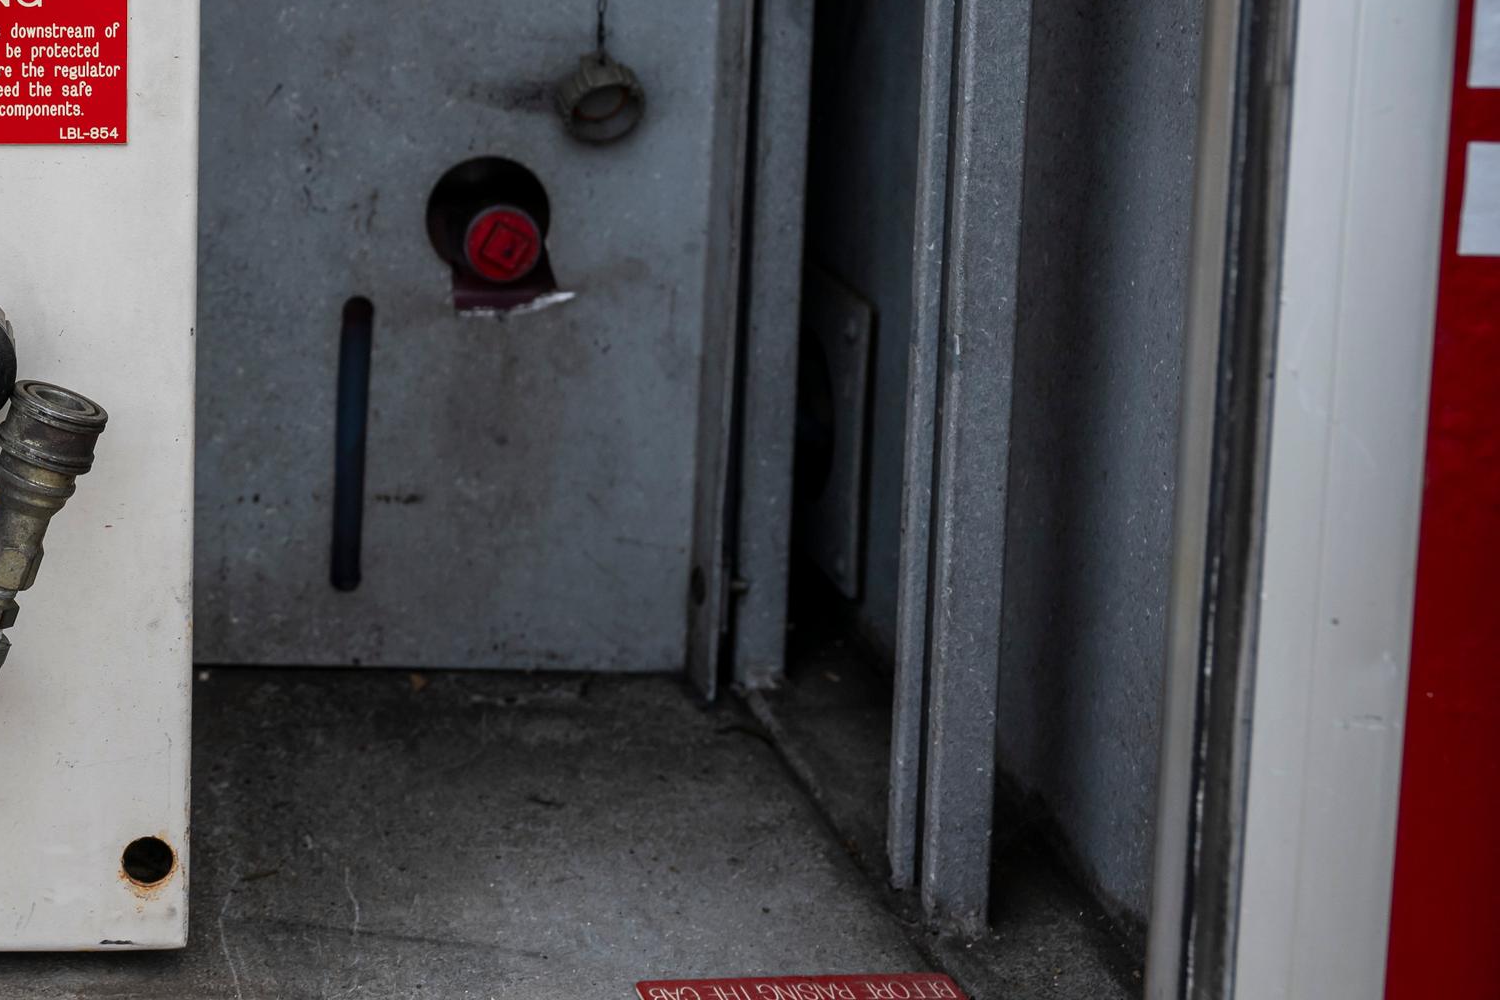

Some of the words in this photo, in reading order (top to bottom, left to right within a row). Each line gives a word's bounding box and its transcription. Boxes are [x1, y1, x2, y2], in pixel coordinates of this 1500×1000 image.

[10, 23, 95, 39] downstream
[105, 22, 120, 38] of
[6, 43, 22, 58] be
[31, 42, 99, 60] protected
[21, 63, 45, 78] the
[54, 62, 121, 80] regulator
[29, 82, 52, 97] the
[61, 81, 92, 97] safe
[59, 127, 119, 140] LBL-854
[648, 986, 701, 1000] CAB
[702, 985, 751, 1000] THE
[755, 982, 856, 1000] RAISING
[857, 981, 957, 999] BEFORE
